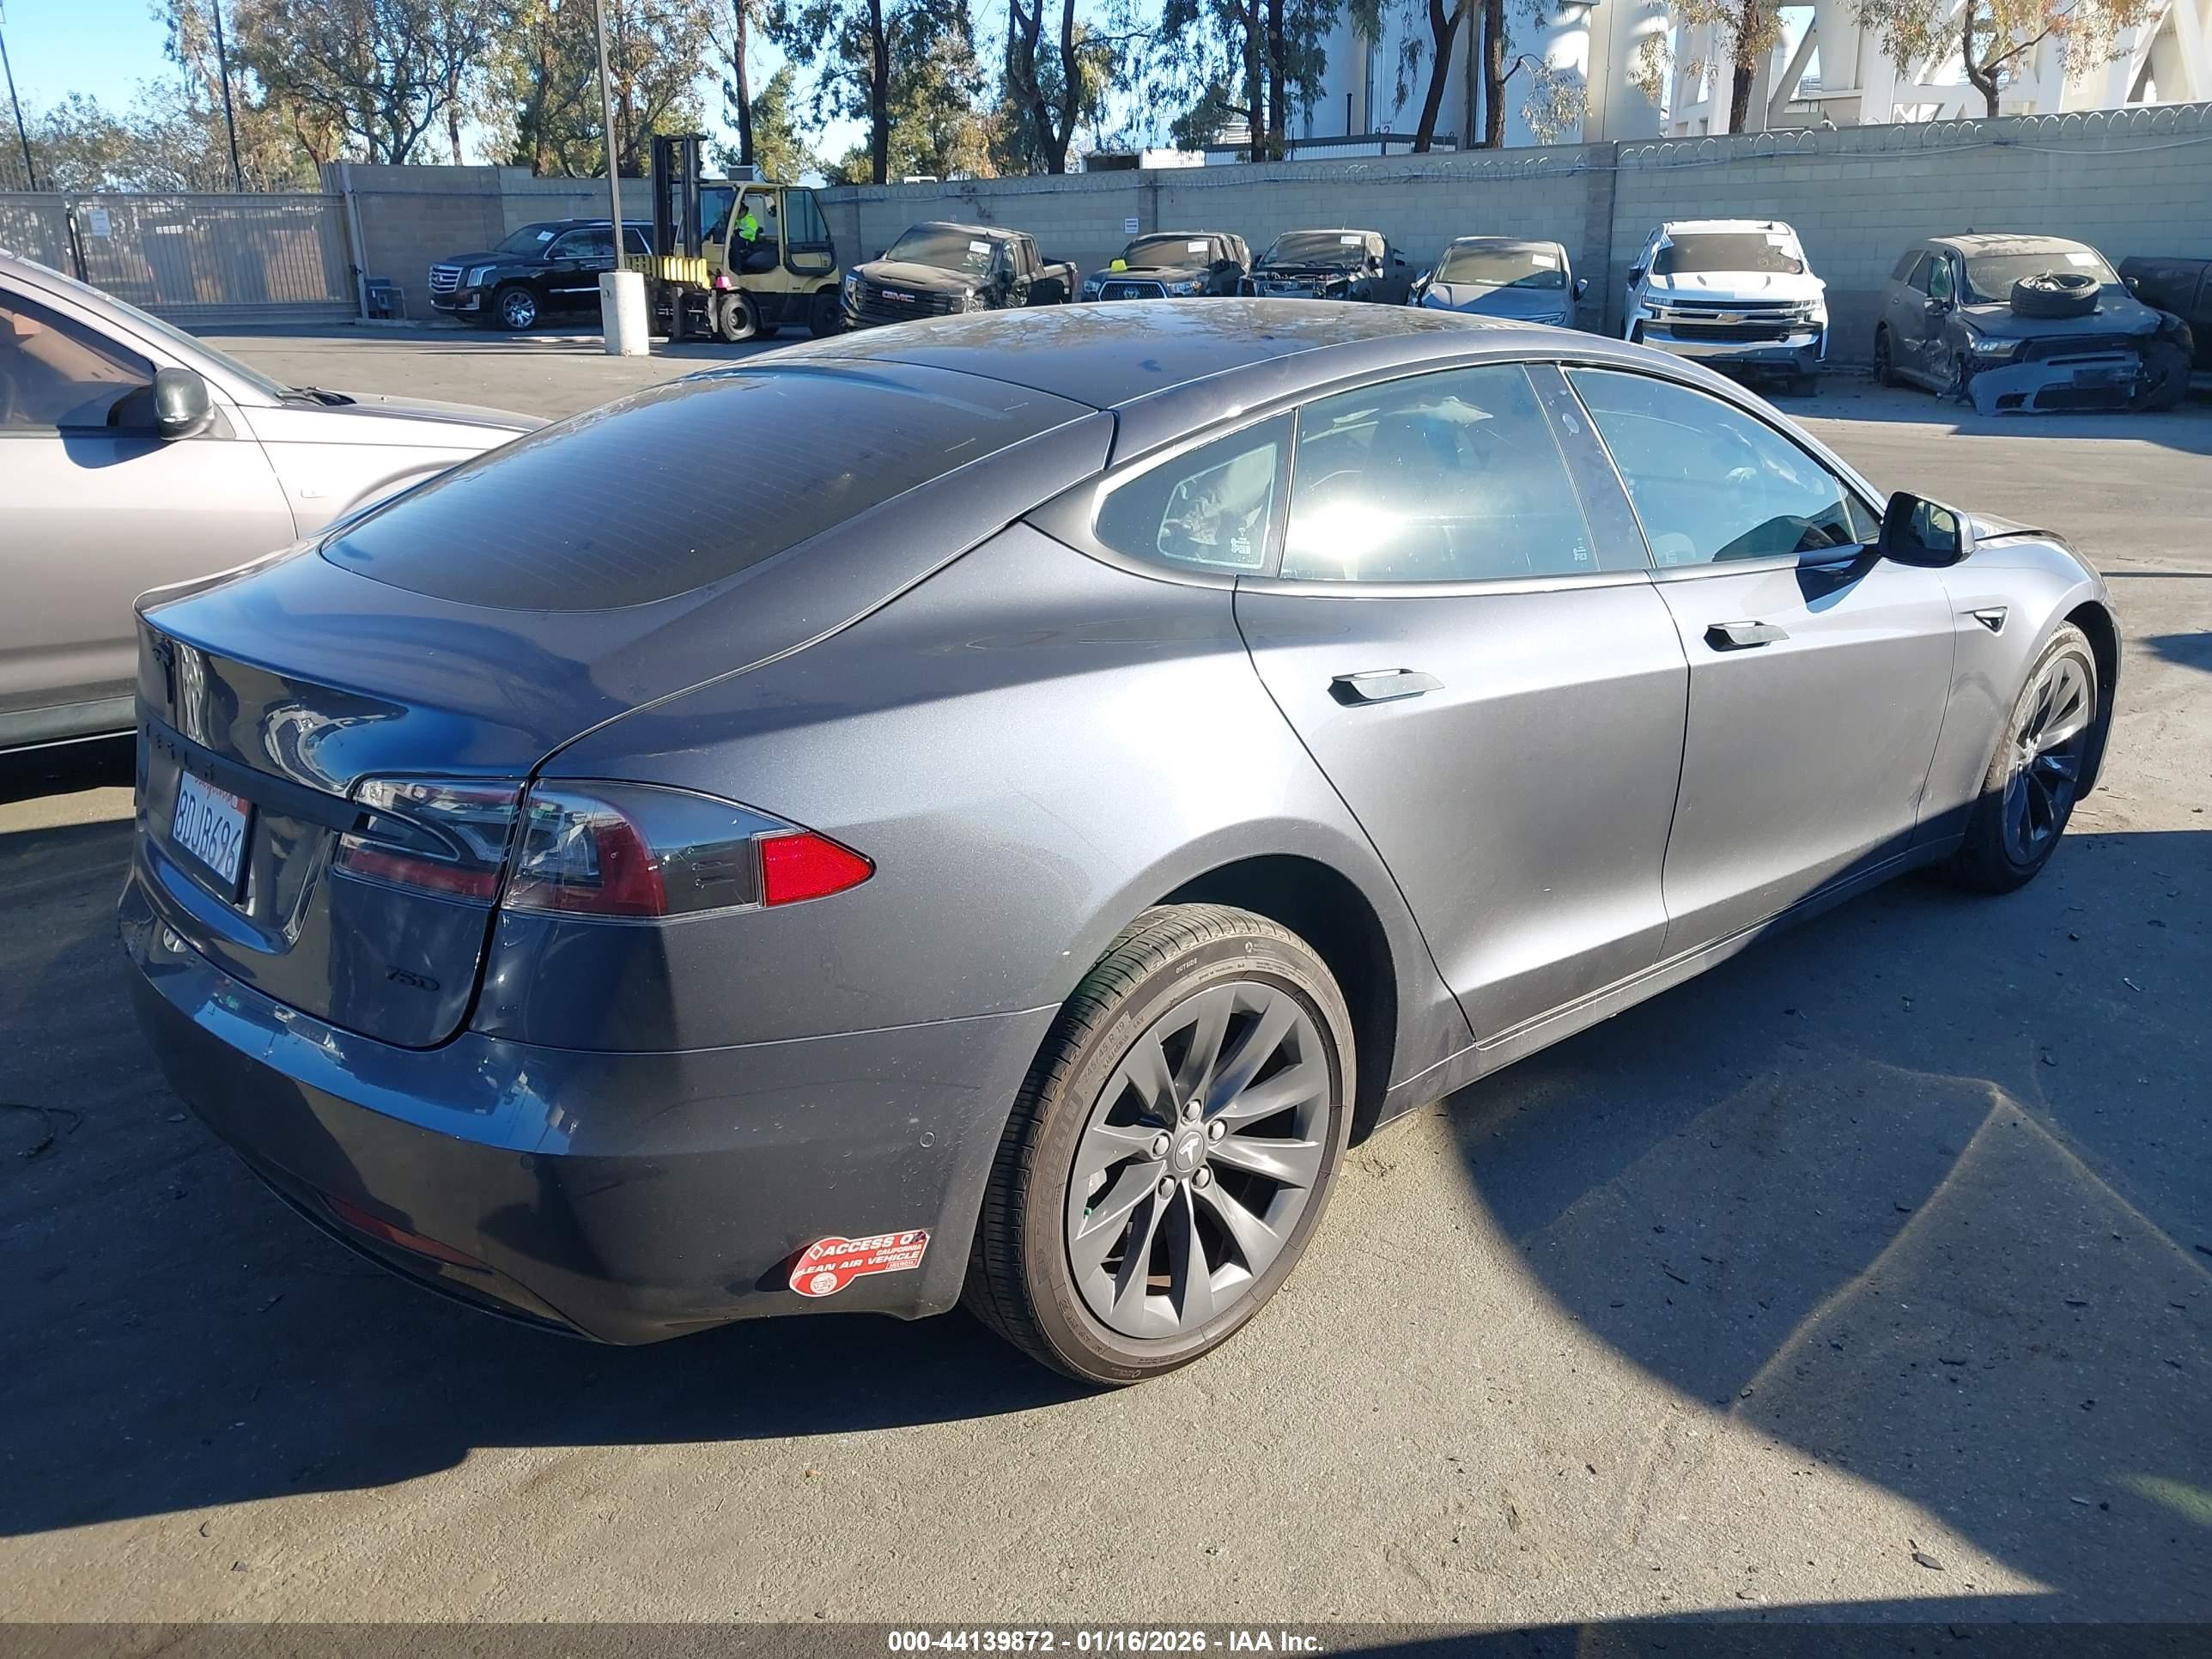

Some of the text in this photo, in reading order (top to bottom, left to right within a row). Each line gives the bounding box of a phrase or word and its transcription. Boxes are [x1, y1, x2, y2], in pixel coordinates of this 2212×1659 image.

[881, 289, 916, 304] GMC
[174, 789, 241, 878] 8DJB696
[1175, 957, 1198, 975] OUTSIDE
[384, 965, 441, 992] 75D
[822, 1236, 895, 1257] ACCESS
[876, 1244, 922, 1256] CALIFORNIA
[794, 1250, 921, 1279] CLEAN AIR VEHICLE
